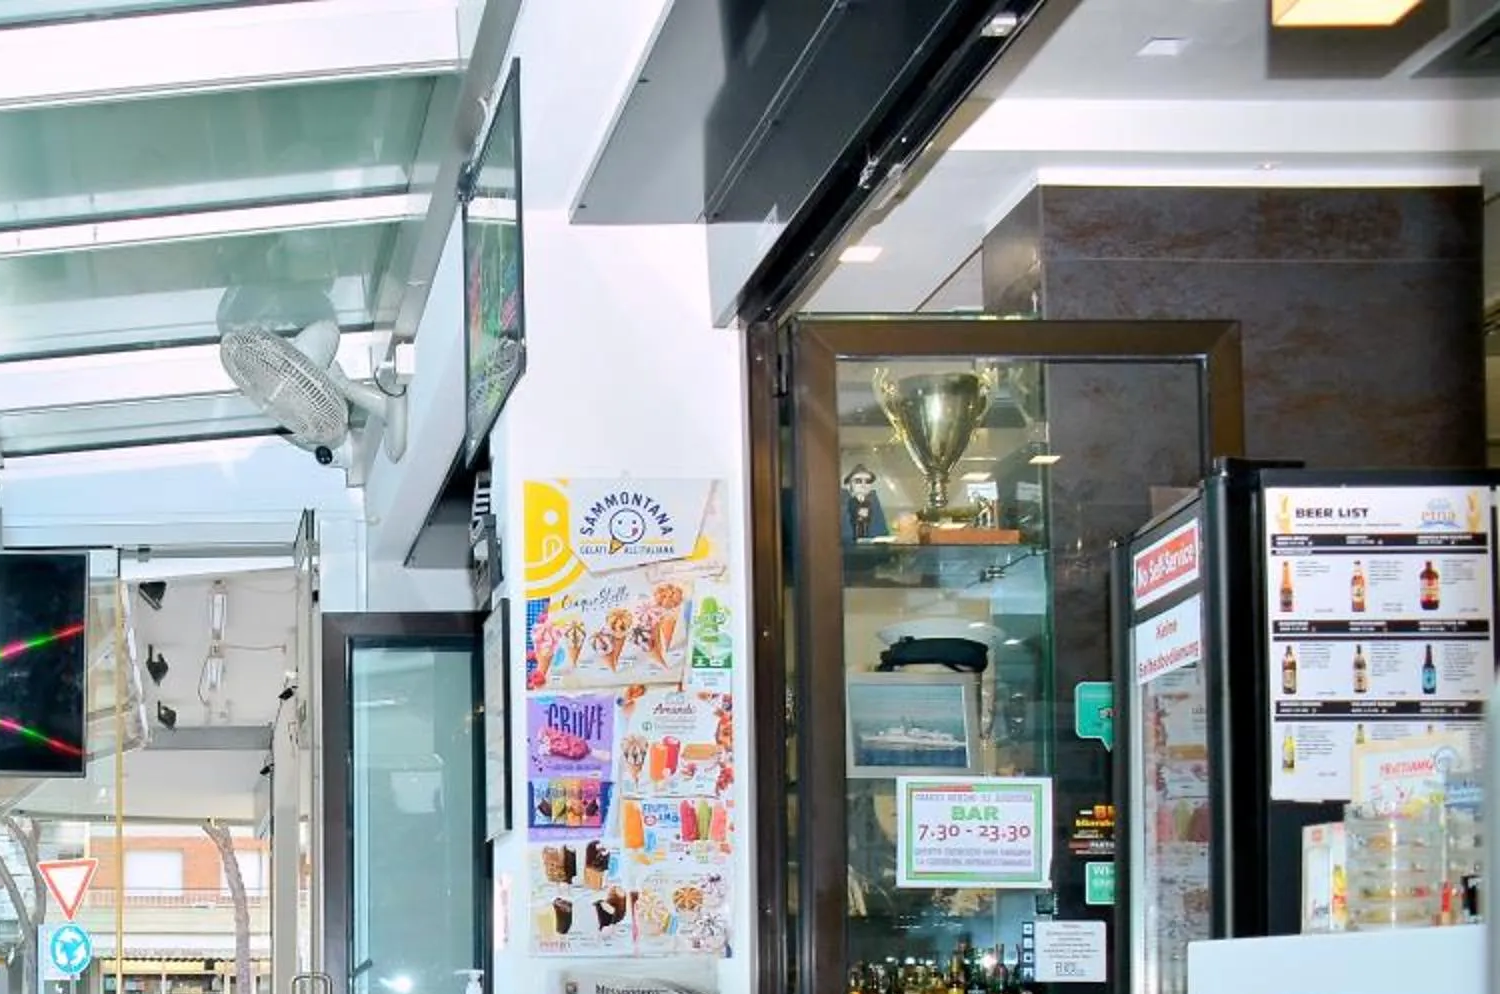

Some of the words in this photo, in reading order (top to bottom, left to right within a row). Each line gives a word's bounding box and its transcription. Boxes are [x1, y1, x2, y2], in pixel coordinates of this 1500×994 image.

[580, 491, 674, 537] SAMMONTANA
[1295, 507, 1333, 519] BEER
[1339, 507, 1369, 519] LIST
[951, 805, 999, 821] BAR
[918, 823, 960, 841] 7.30
[978, 824, 1031, 842] 23.30
